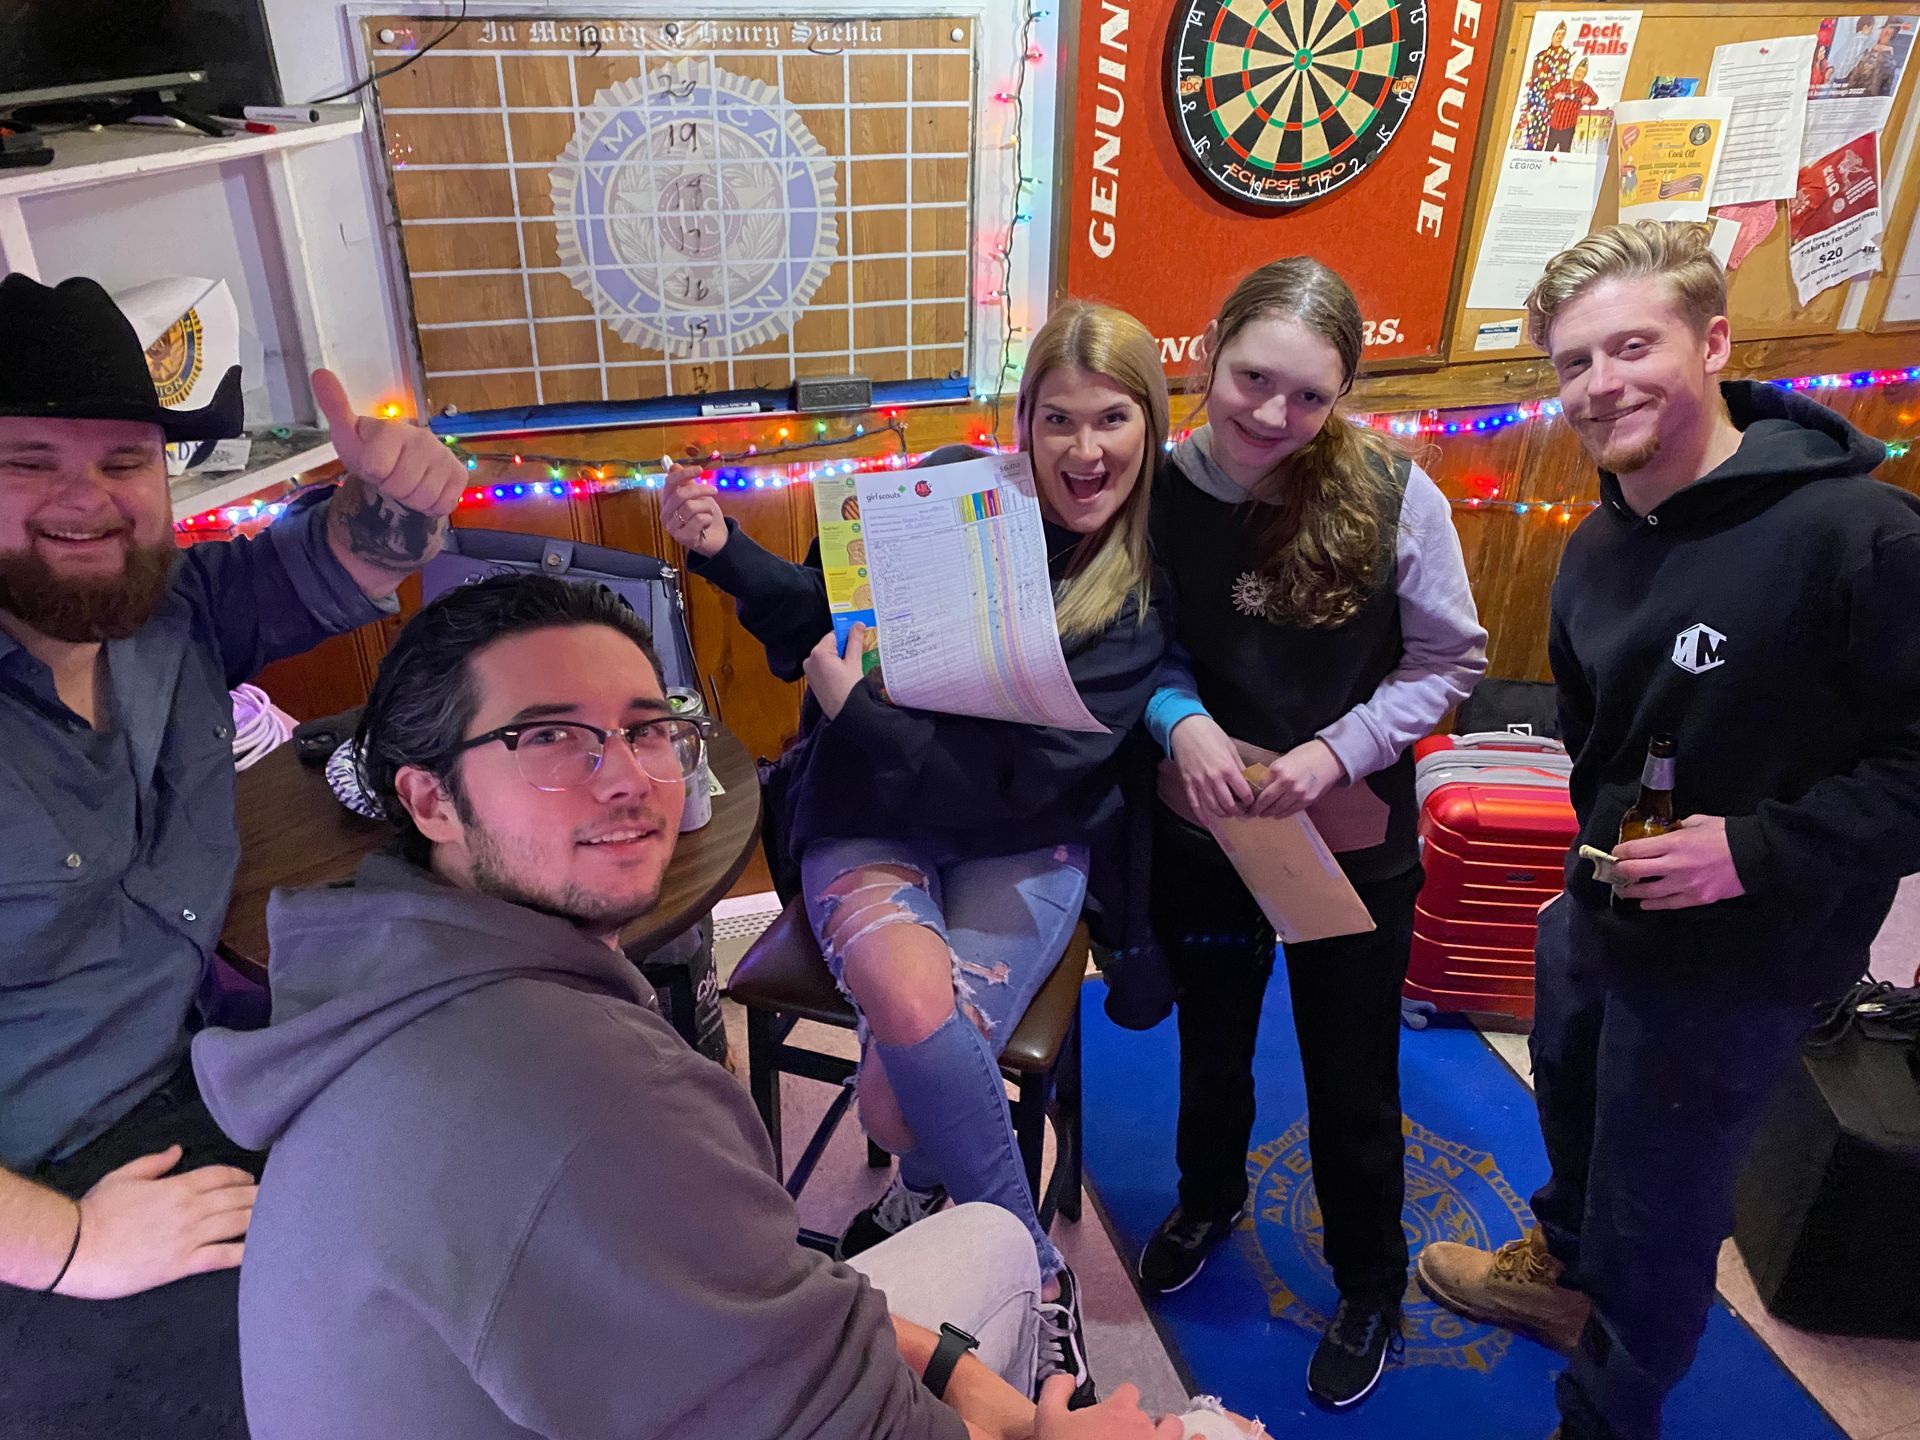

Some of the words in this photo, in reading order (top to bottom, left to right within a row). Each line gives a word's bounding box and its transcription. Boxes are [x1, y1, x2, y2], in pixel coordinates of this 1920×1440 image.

[478, 20, 517, 43] In
[529, 20, 646, 48] Memory
[696, 20, 779, 48] Henry
[1579, 22, 1624, 39] Deck
[1583, 39, 1629, 56] Halls
[1180, 81, 1200, 91] PDC
[1395, 81, 1413, 90] PDC
[1089, 0, 1130, 258] GENUIN
[1416, 0, 1481, 238] ENUINE
[668, 122, 698, 153] 19
[1229, 163, 1300, 190] ECLIPSE
[1307, 162, 1346, 186] PRO
[1509, 162, 1542, 170] LEGION
[1823, 164, 1840, 197] RED
[1801, 241, 1830, 257] T-shirts
[1831, 235, 1843, 244] for
[1844, 224, 1861, 238] sale!
[1819, 247, 1843, 264] $20
[626, 284, 783, 335] LEGION
[866, 492, 878, 503] girl
[879, 492, 901, 500] scouts
[1261, 1144, 1464, 1226] AMEAN
